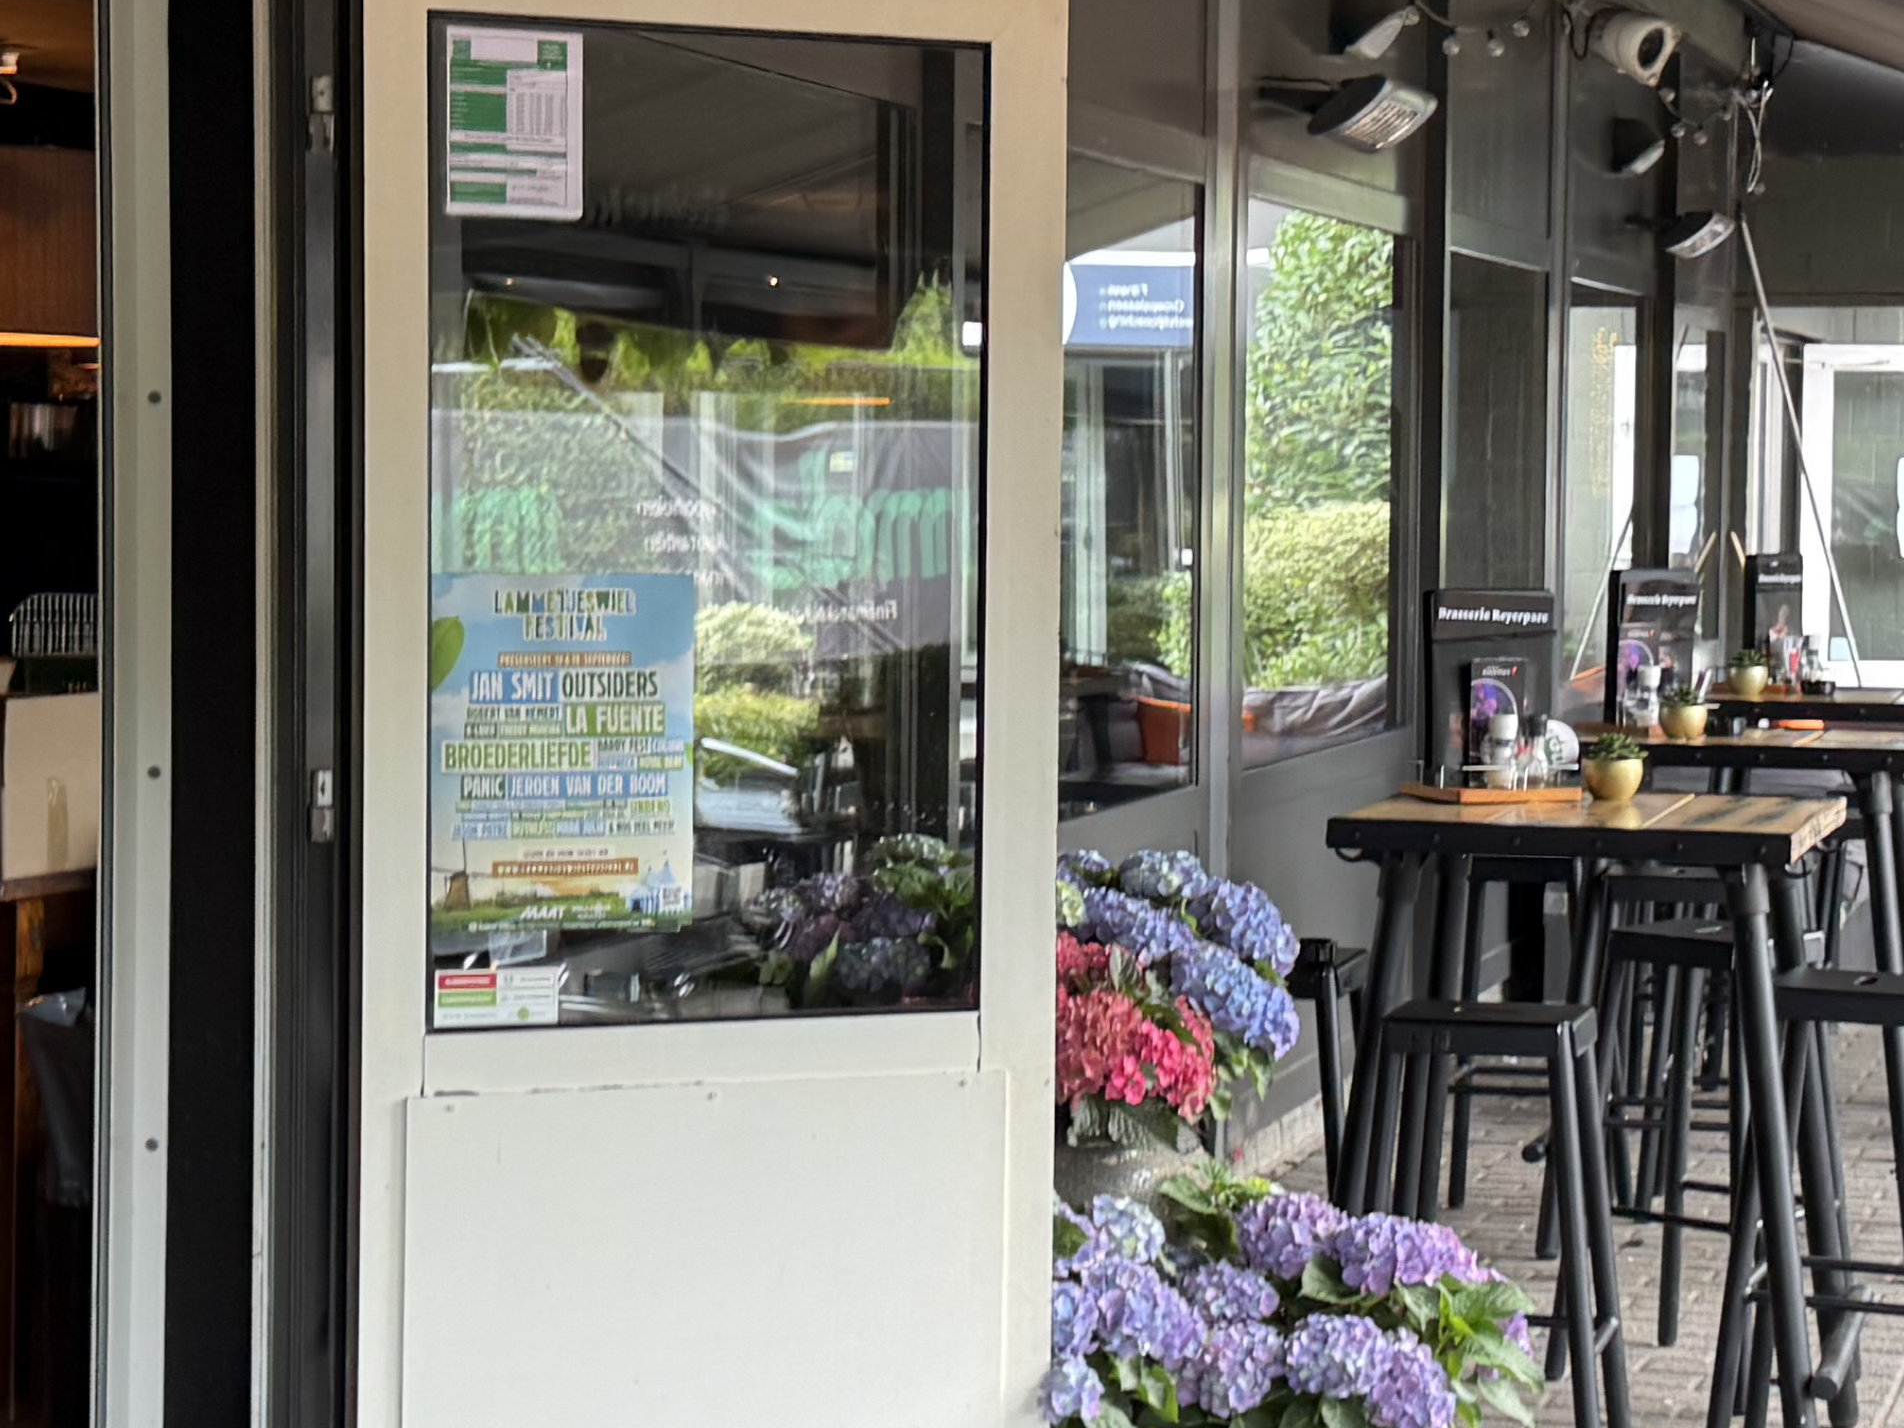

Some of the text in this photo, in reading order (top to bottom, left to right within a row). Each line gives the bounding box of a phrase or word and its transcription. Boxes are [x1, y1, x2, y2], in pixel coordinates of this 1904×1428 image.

[523, 613, 608, 641] FESTIVAL
[1438, 606, 1490, 621] Brasserie
[472, 671, 658, 700] JAN SMIT OUTSIDERS
[566, 704, 588, 734] LA
[597, 703, 664, 734] FUENTE
[445, 742, 592, 770] BROEDERLIEFDE
[463, 773, 666, 798] PANIC JEROEN VAN DER BOOM
[520, 905, 565, 920] MAAT
